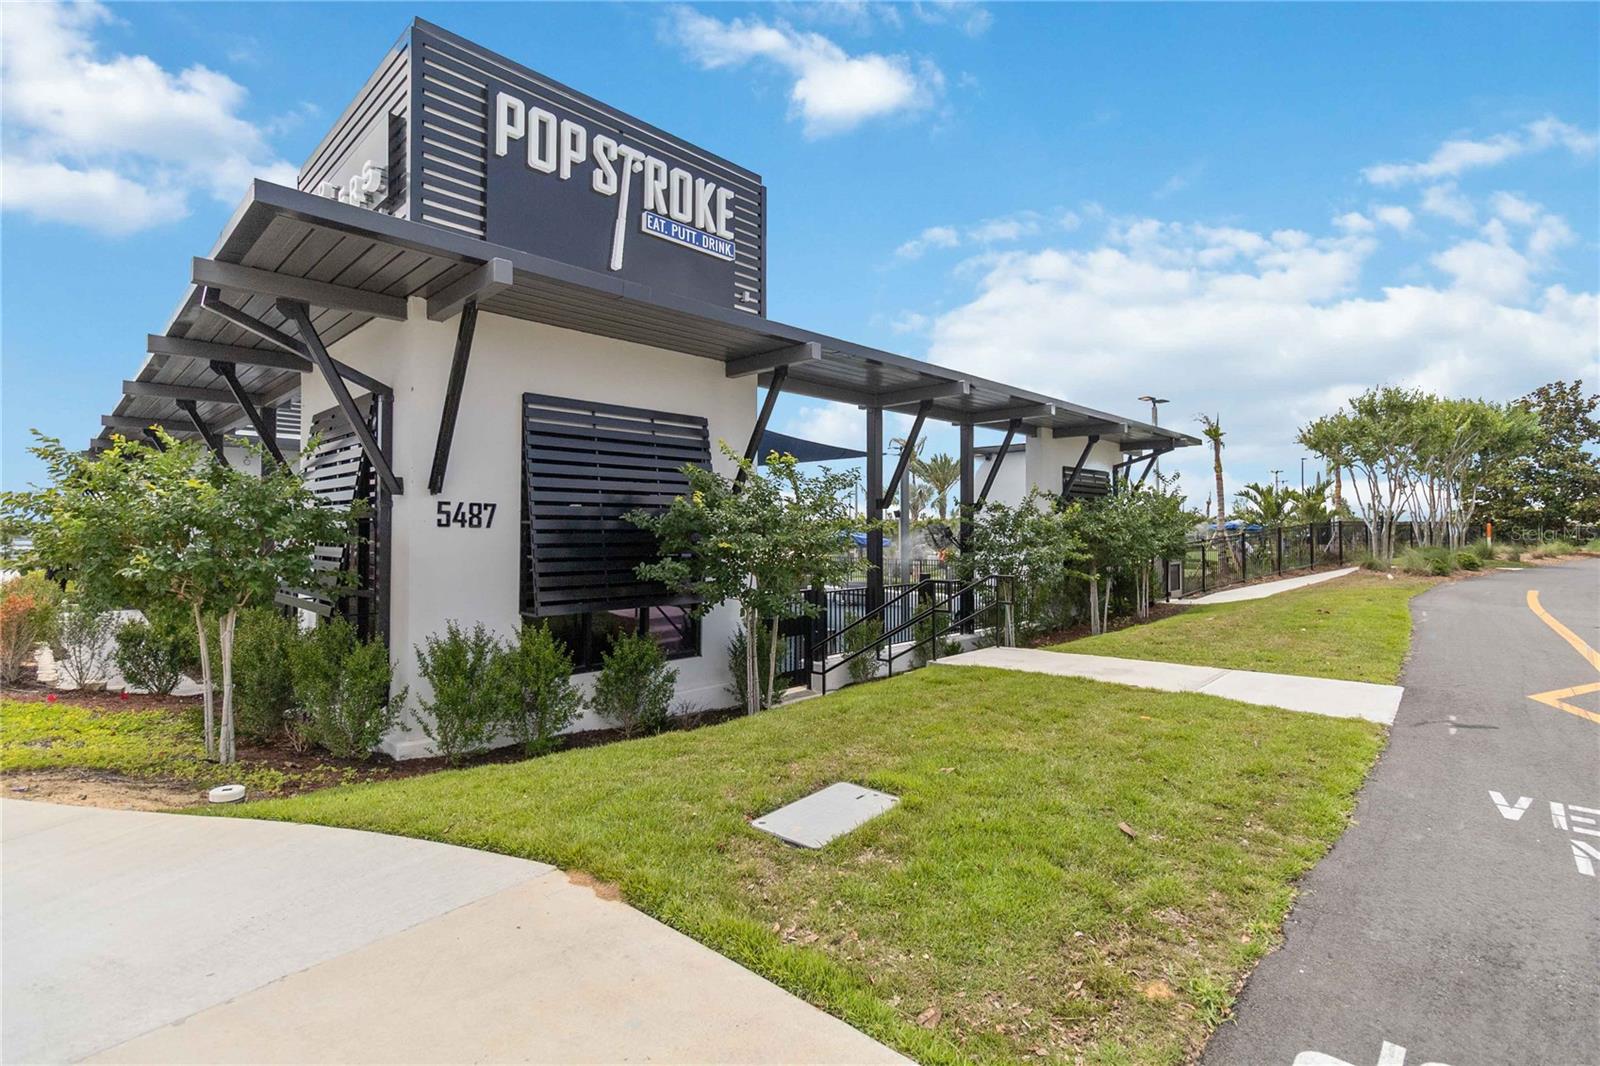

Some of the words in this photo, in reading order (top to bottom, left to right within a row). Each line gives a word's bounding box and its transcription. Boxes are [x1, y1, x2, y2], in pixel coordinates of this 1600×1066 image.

[496, 91, 735, 270] POPSTROKE
[647, 215, 668, 235] EAT.
[671, 223, 700, 246] PUTT.
[702, 235, 735, 257] DRINK.
[437, 501, 497, 528] 5487
